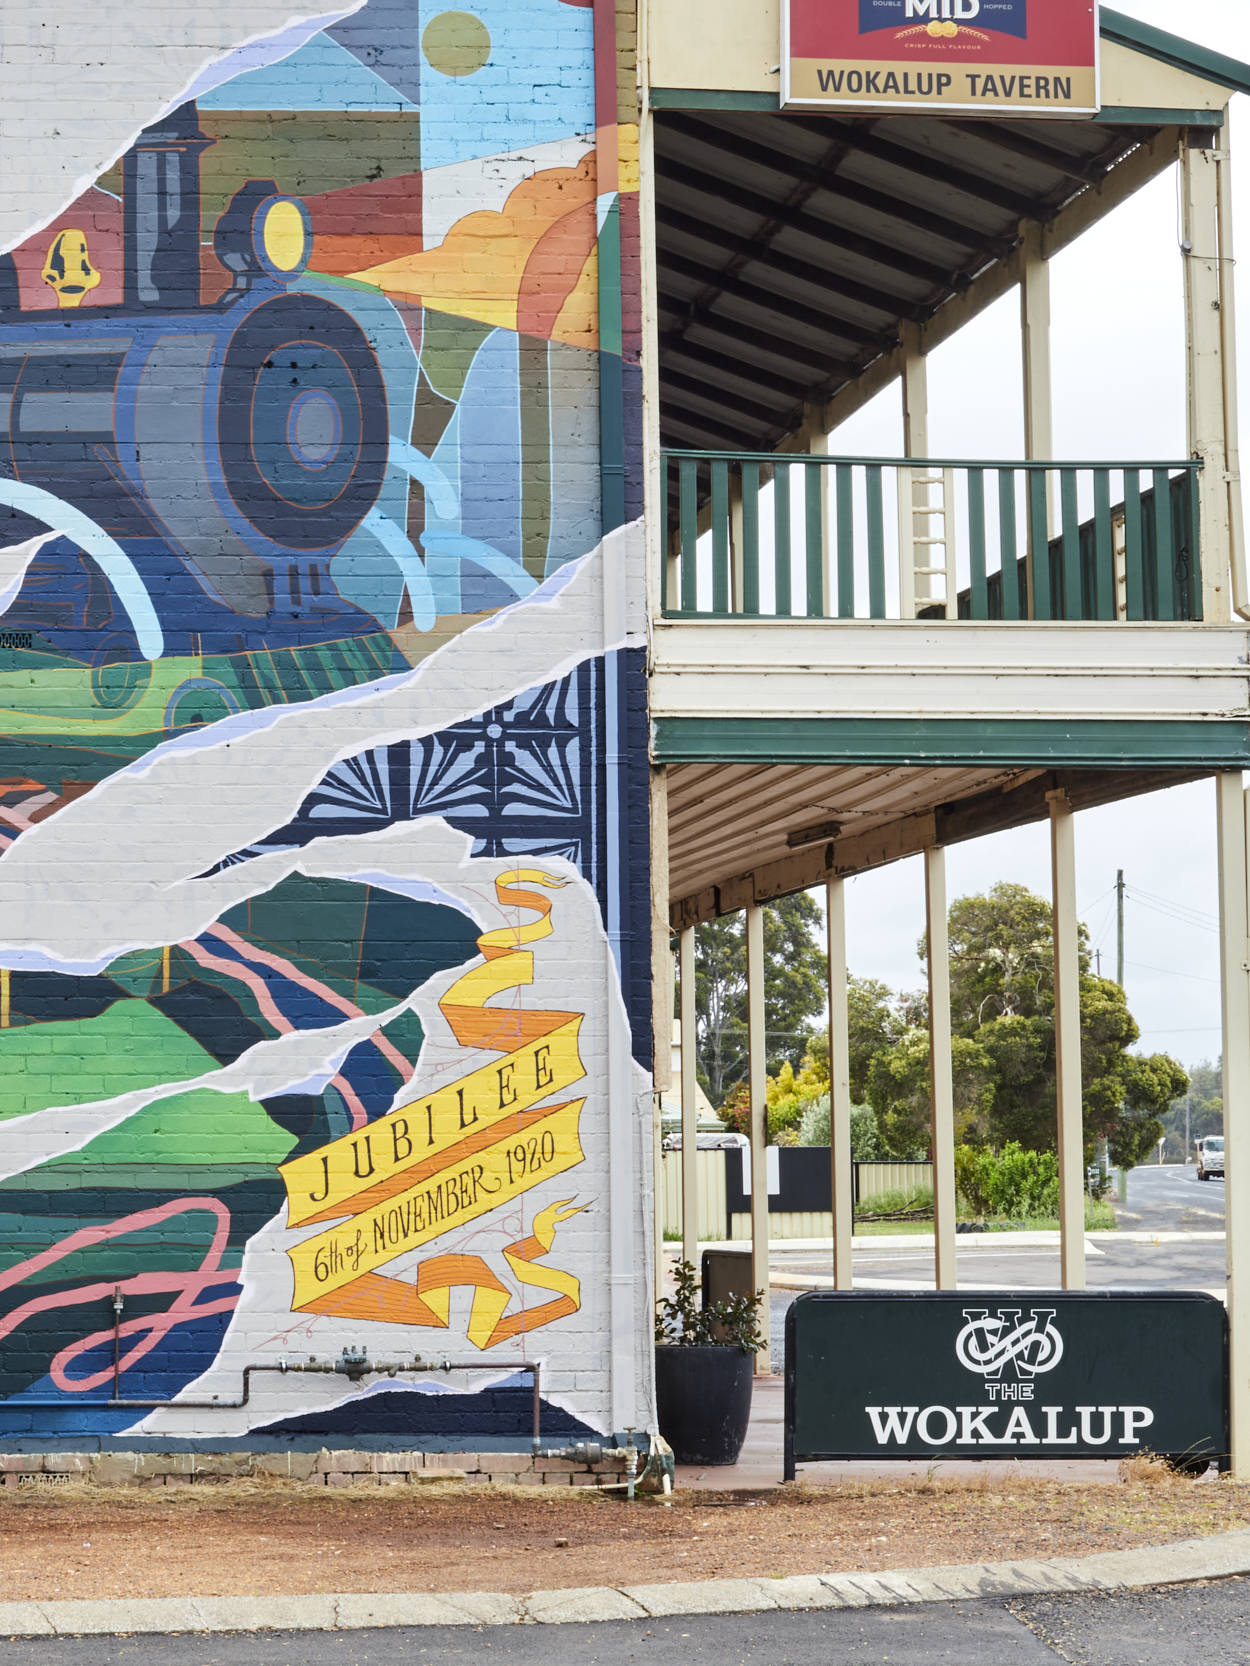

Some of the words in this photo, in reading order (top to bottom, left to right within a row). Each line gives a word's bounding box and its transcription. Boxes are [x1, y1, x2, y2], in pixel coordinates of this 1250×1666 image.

[816, 69, 951, 96] WOKALUP
[965, 73, 1072, 100] TAVERN
[309, 1044, 554, 1202] JUBILEE
[373, 1163, 502, 1255] NOVEMBER
[505, 1130, 555, 1186] 1920
[985, 1383, 1034, 1400] THE
[865, 1405, 1155, 1445] WOKALUP
